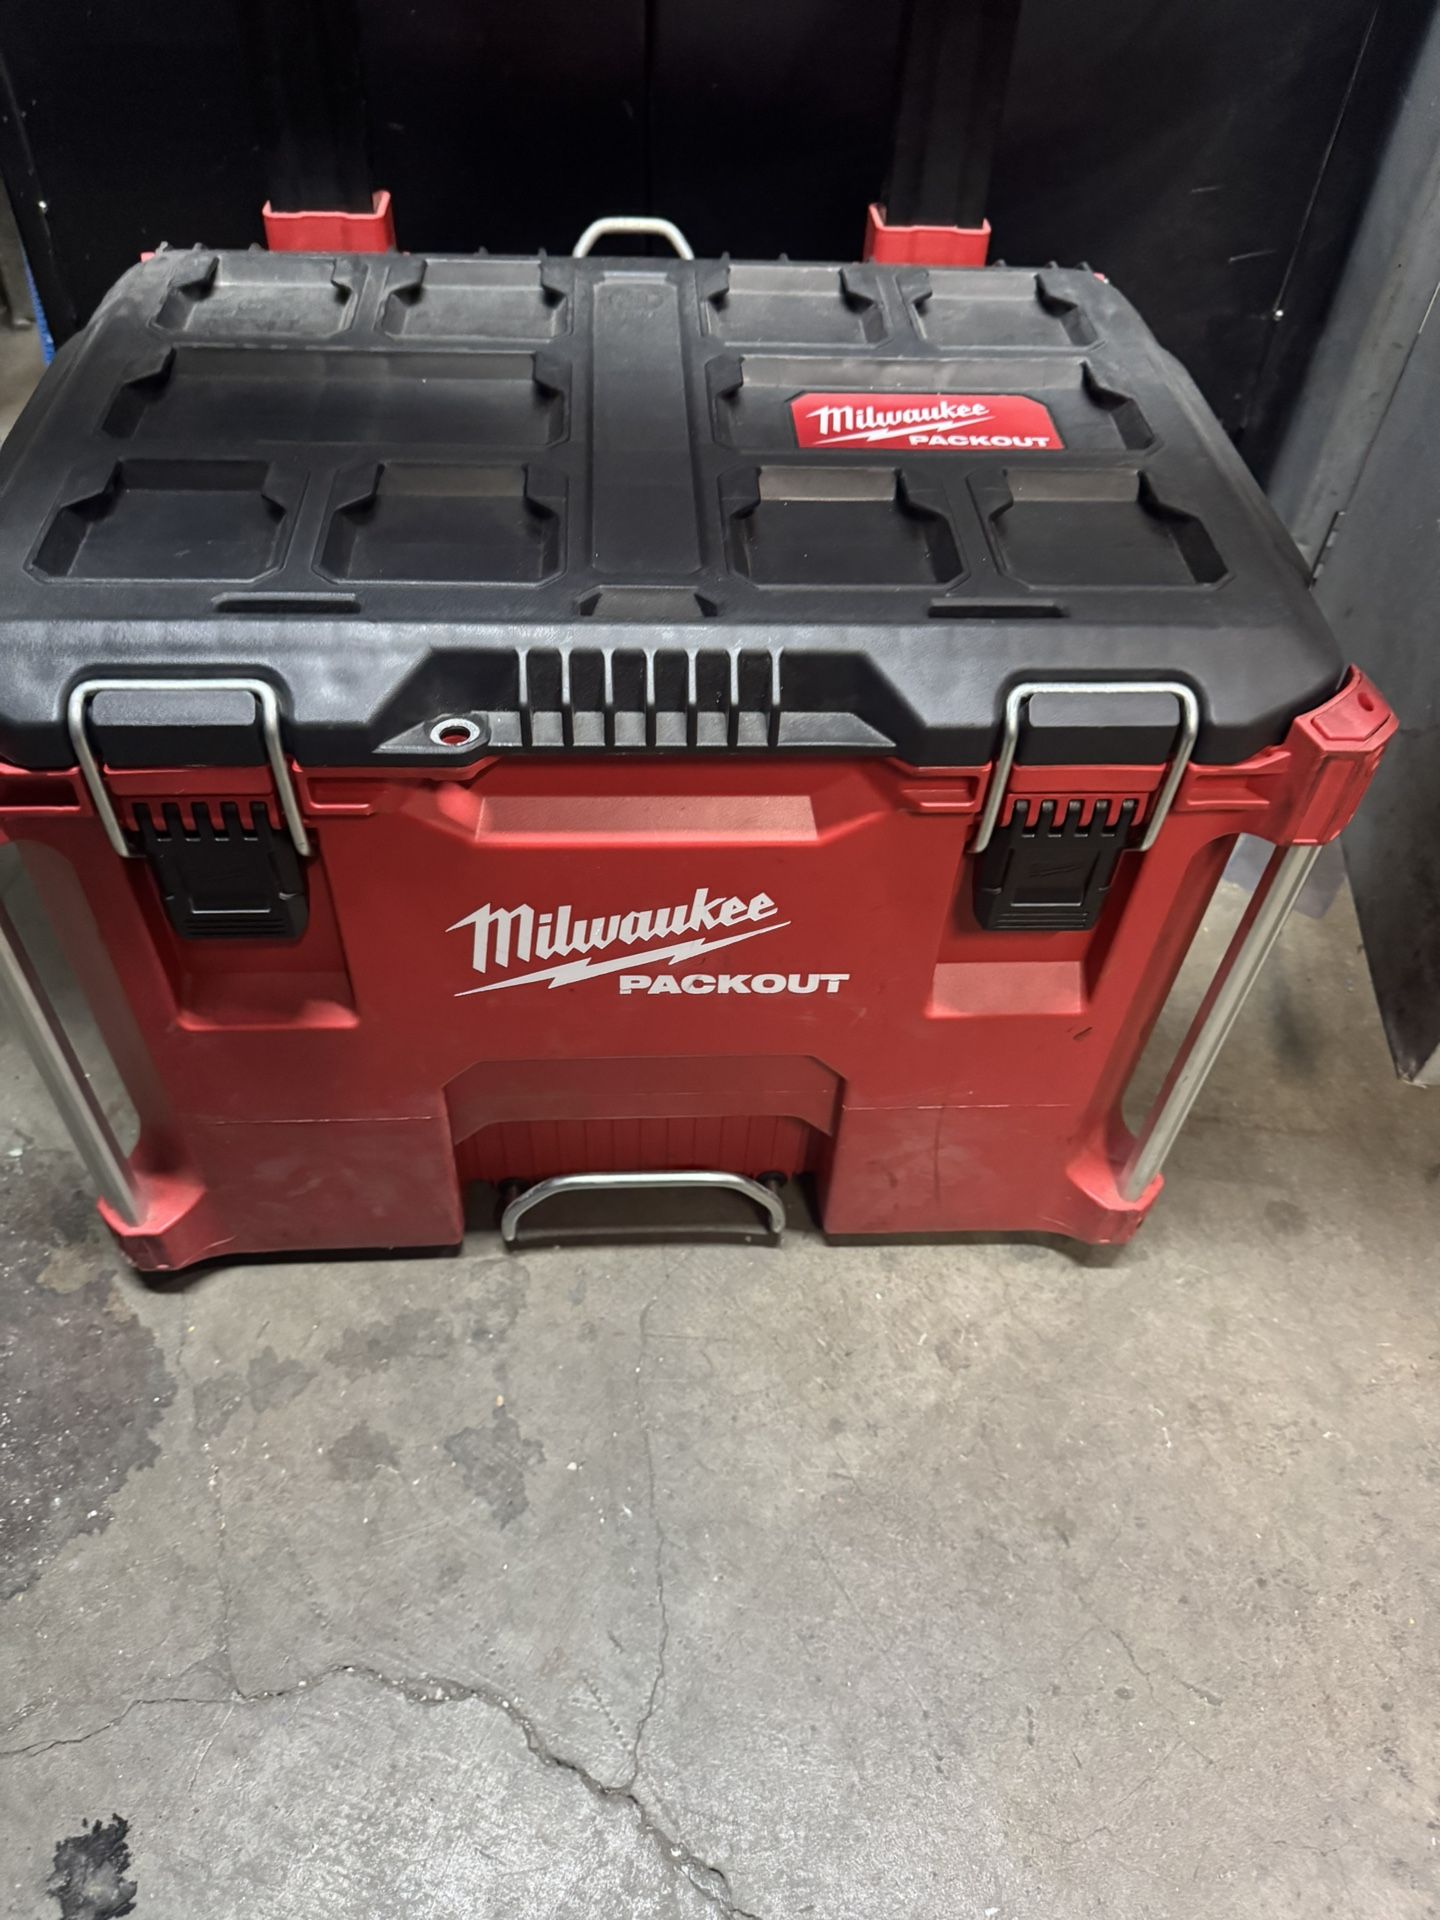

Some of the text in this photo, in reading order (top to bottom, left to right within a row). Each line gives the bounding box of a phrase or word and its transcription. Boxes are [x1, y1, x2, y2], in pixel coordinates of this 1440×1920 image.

[806, 401, 990, 435] Milwaukee
[909, 435, 1050, 448] PACKOUT
[445, 888, 778, 974] Milwaukee
[619, 974, 850, 995] PACKOUT
